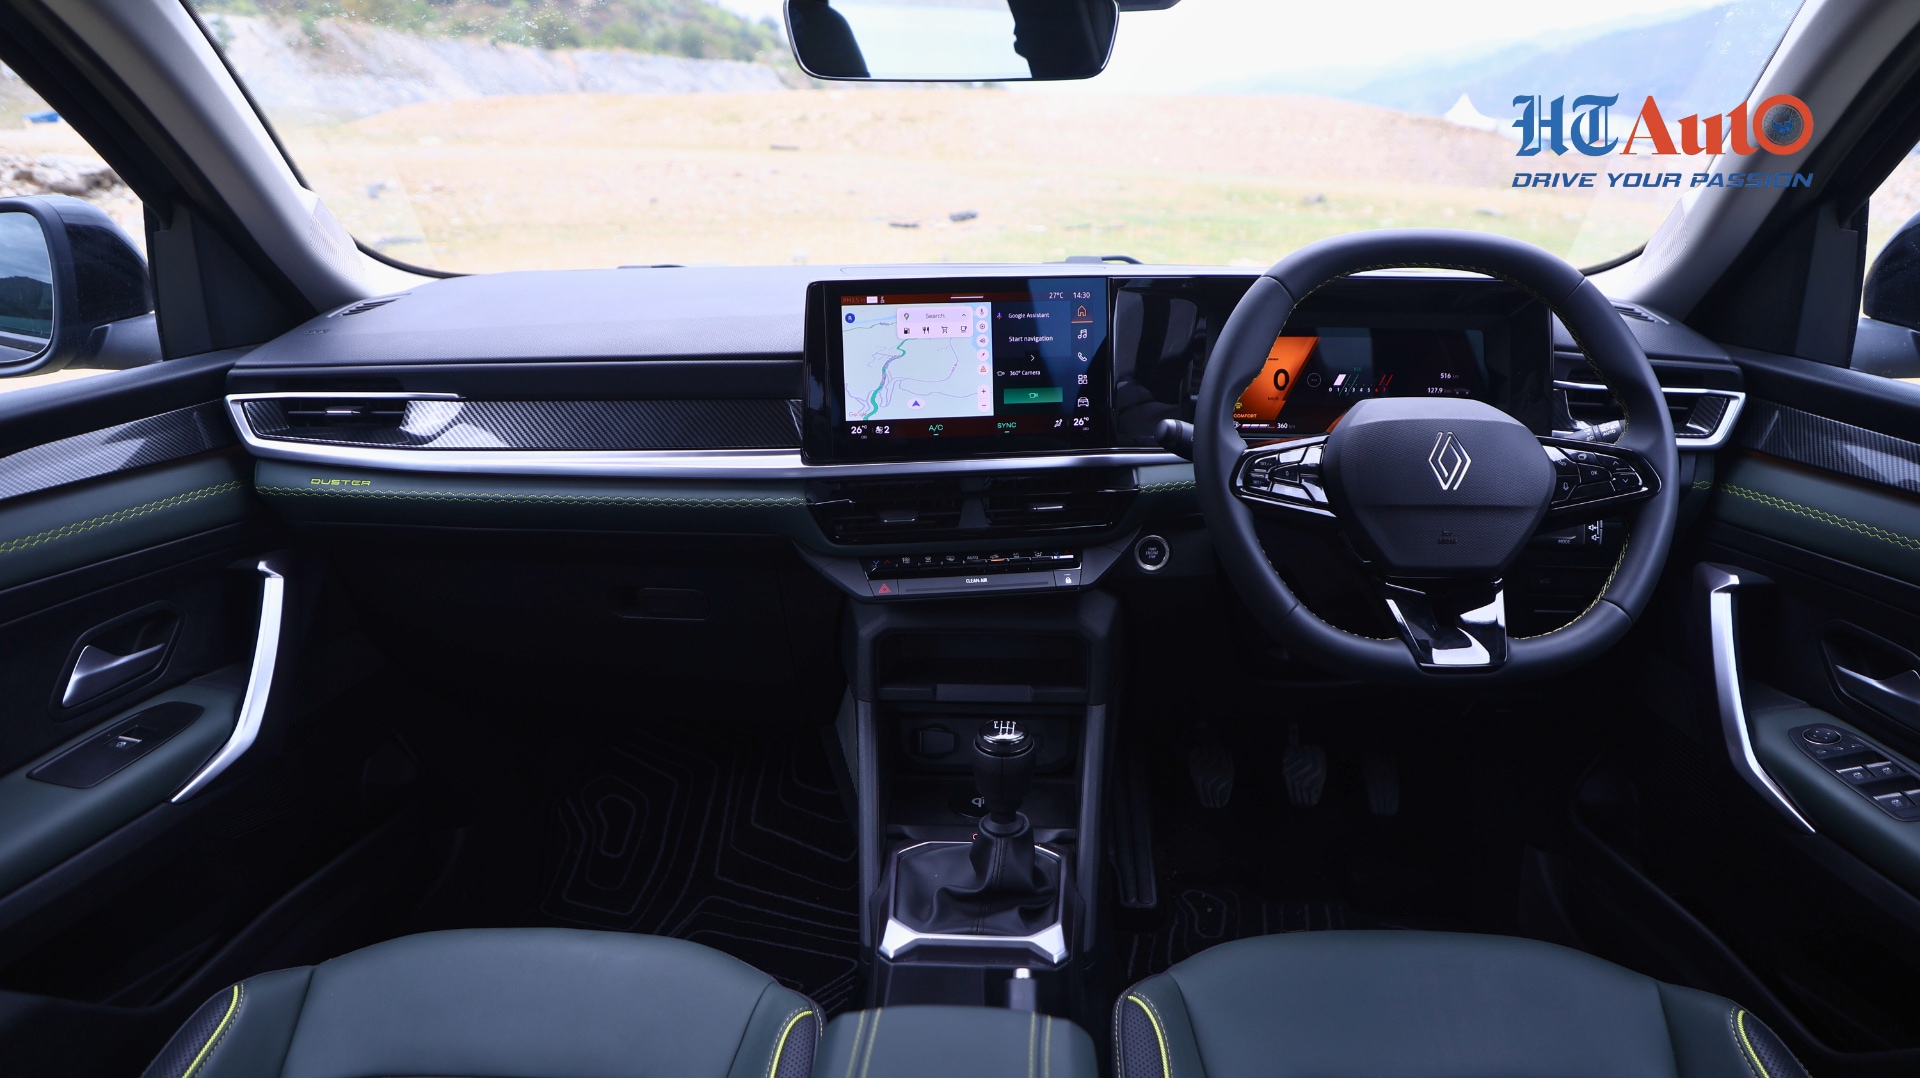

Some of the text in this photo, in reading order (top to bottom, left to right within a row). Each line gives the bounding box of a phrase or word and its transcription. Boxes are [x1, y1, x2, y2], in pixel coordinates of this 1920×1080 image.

[925, 312, 945, 320] Search
[1008, 312, 1026, 320] Google
[1023, 335, 1054, 343] navigation
[1273, 368, 1290, 391] 0
[883, 425, 890, 434] 2
[928, 424, 944, 432] A/C
[310, 477, 371, 486] DUSTER
